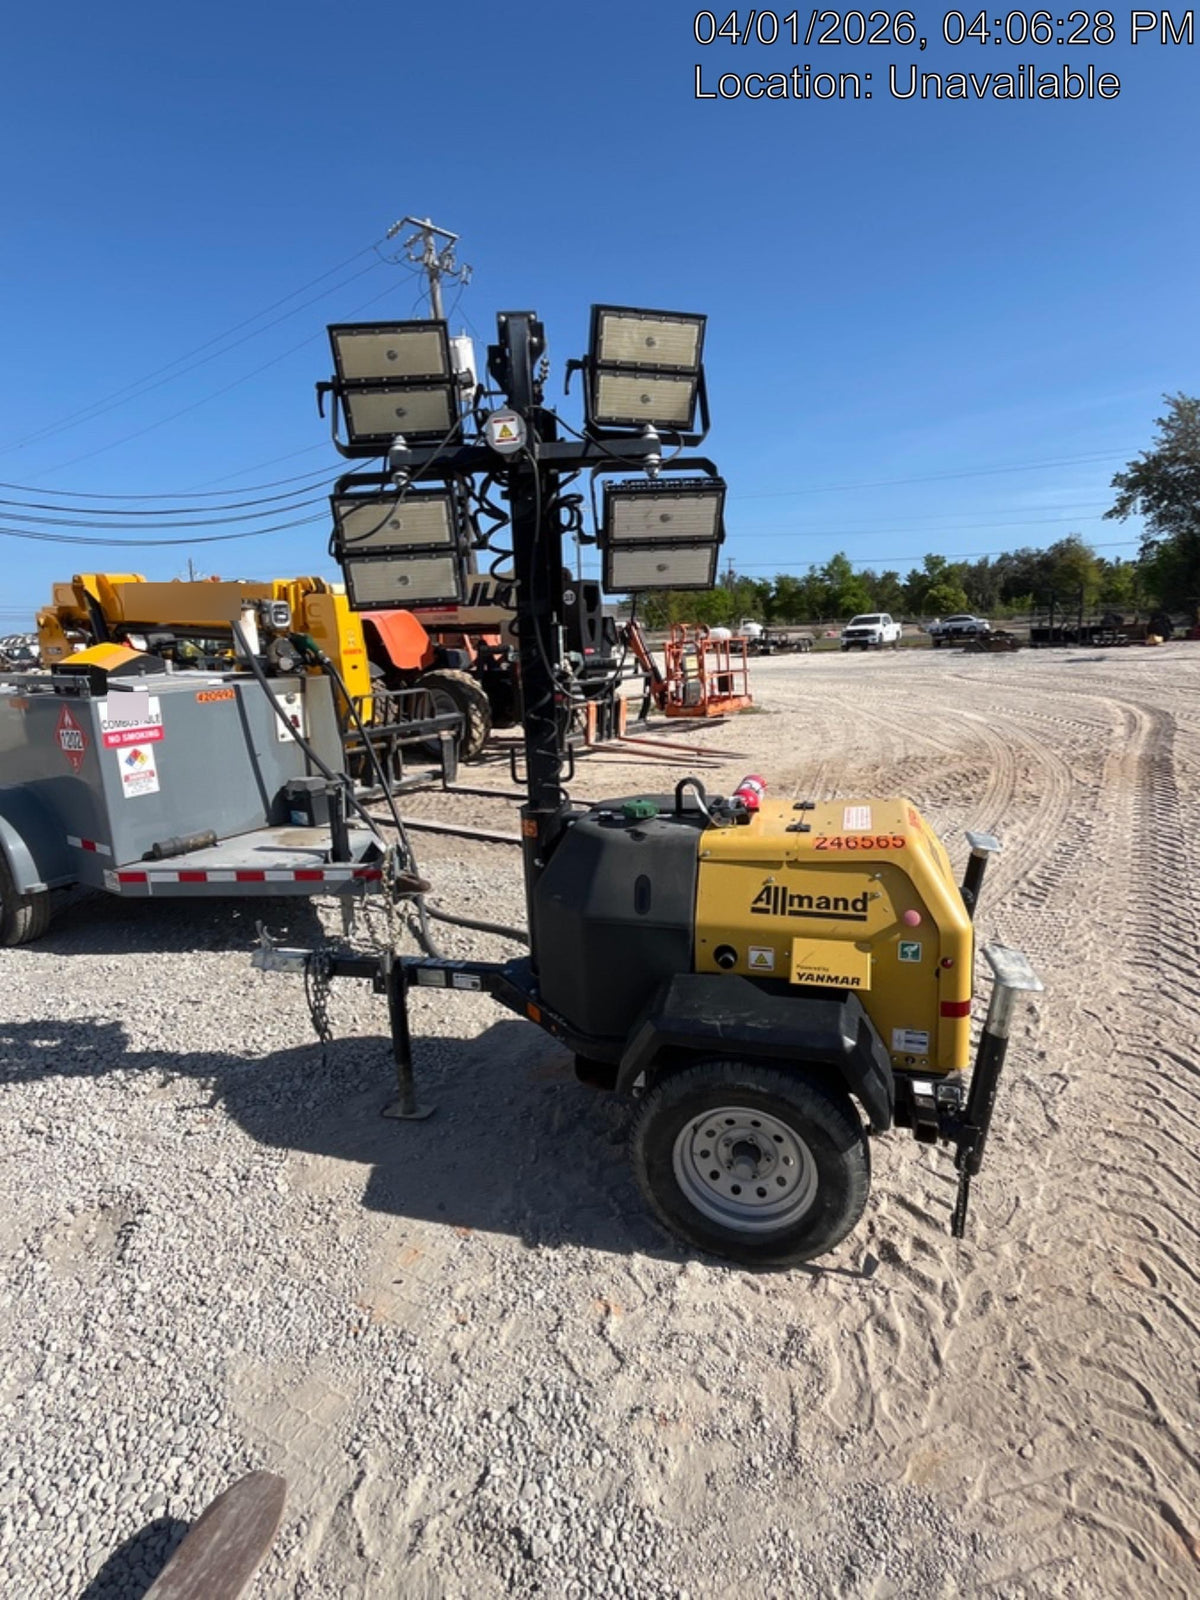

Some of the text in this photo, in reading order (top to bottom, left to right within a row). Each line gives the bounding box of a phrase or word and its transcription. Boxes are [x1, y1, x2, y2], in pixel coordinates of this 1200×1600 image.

[60, 730, 83, 749] 1202
[107, 728, 160, 744] NO SMOKING
[814, 834, 906, 851] 246565
[751, 884, 868, 917] Allmand
[796, 972, 861, 986] YANMAR
